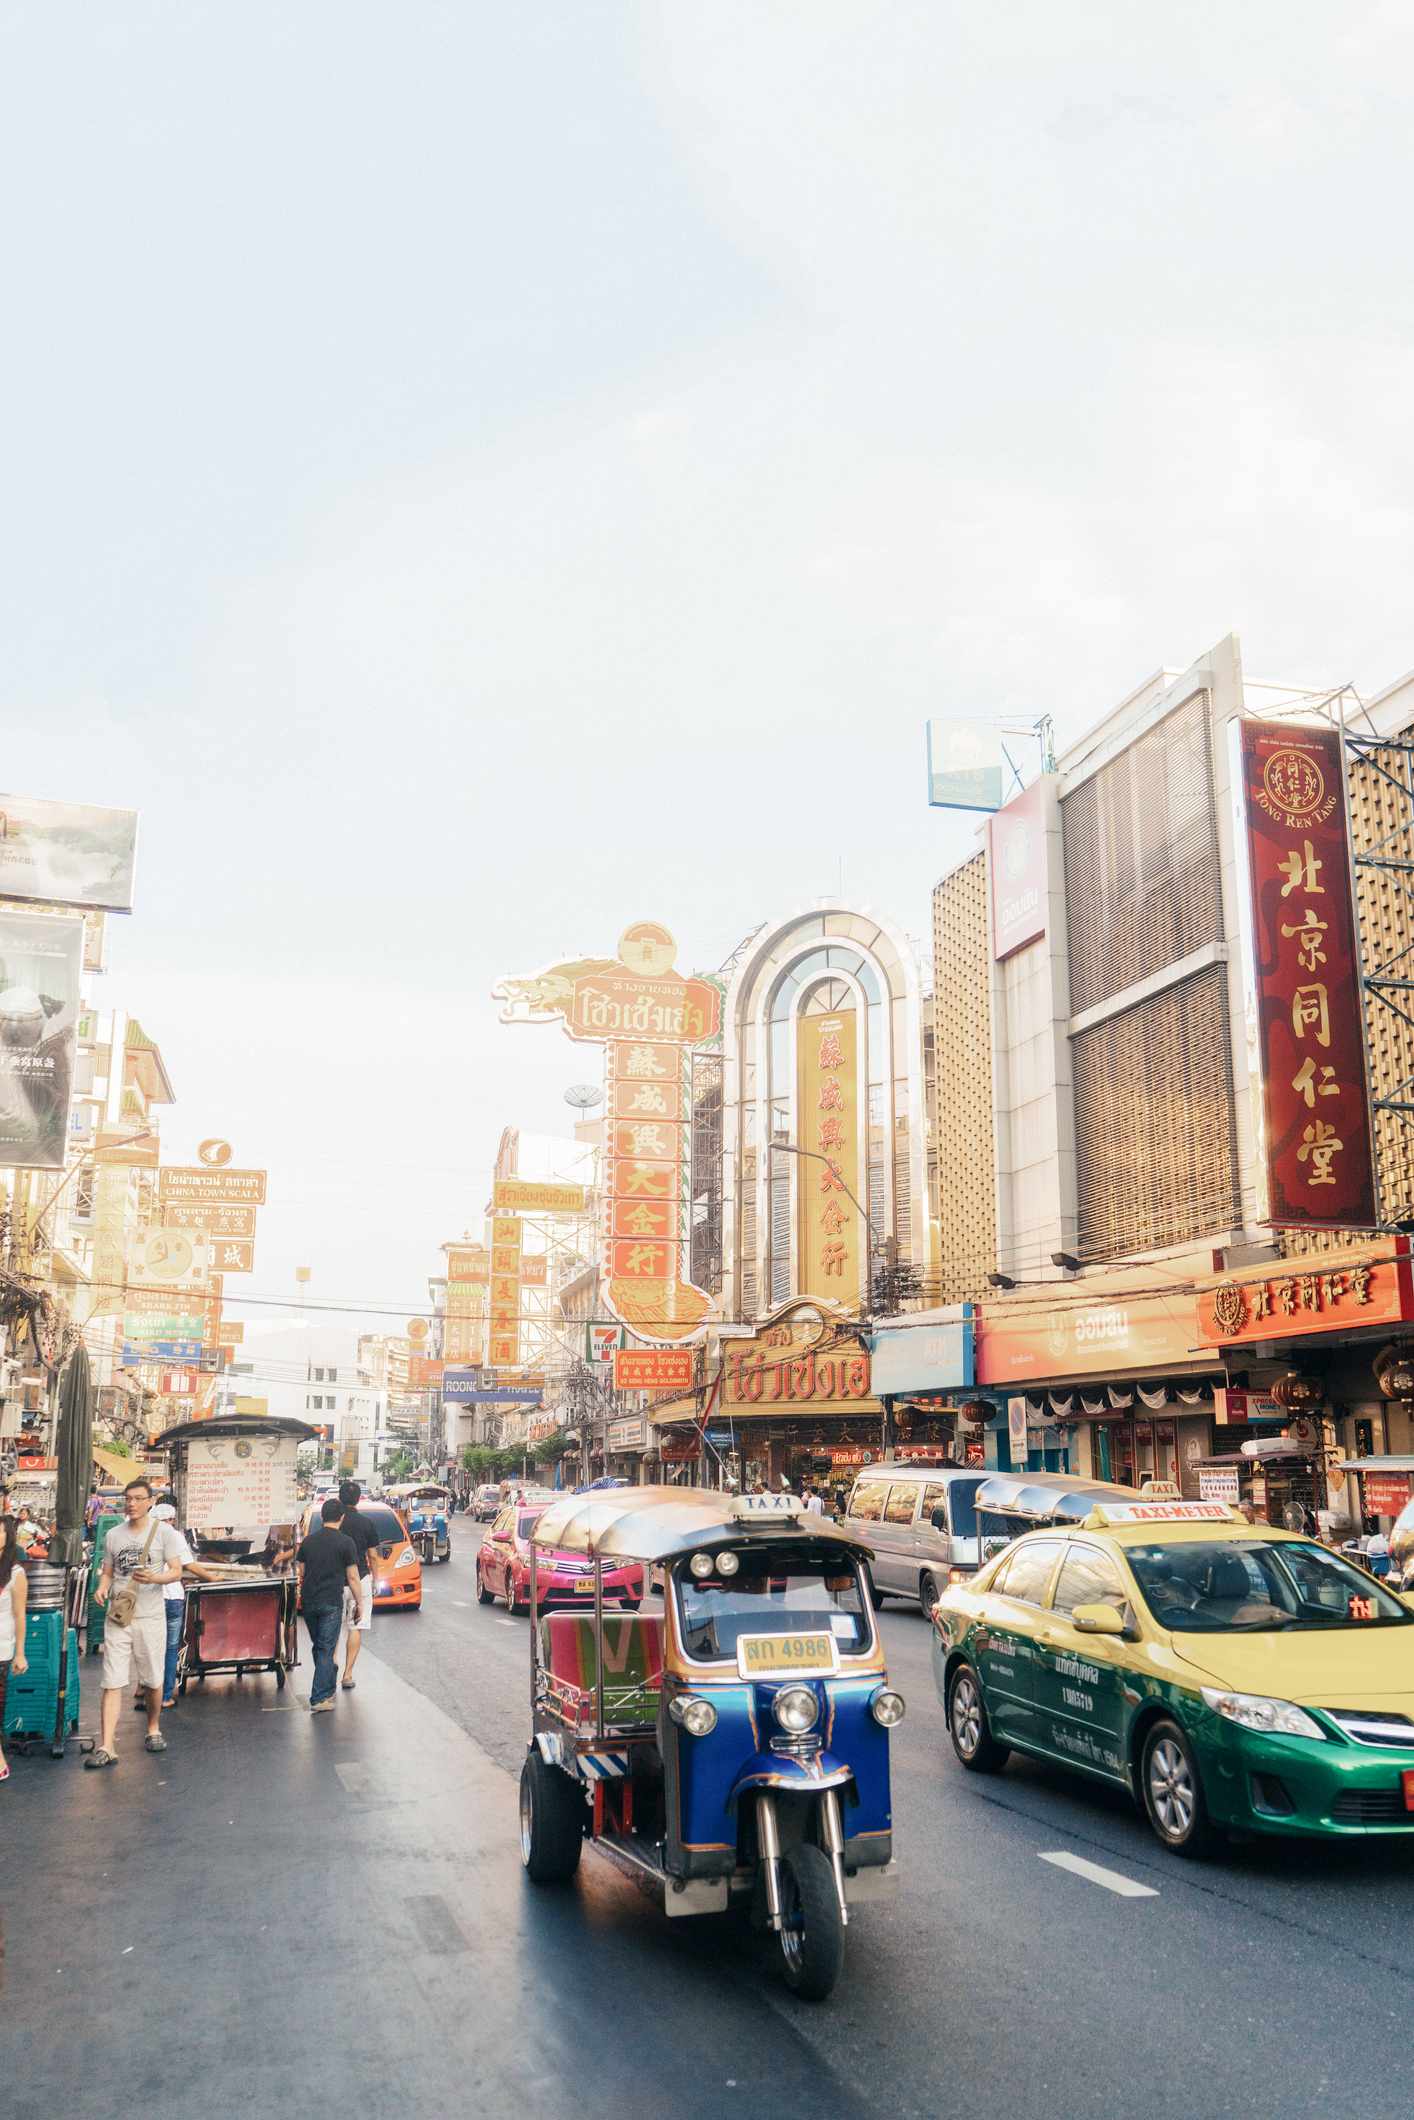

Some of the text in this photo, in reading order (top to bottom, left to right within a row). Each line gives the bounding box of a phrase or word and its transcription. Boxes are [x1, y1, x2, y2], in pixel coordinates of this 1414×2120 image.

[1254, 789, 1337, 829] TONG REN TANG
[1277, 839, 1344, 1186] 北京同仁堂
[166, 1188, 260, 1199] CHINA TOWN SCALA
[1252, 1266, 1371, 1321] 北京同仁堂
[745, 1497, 793, 1509] TAXI
[1129, 1505, 1228, 1519] TAXI-METER
[783, 1638, 826, 1658] 4986
